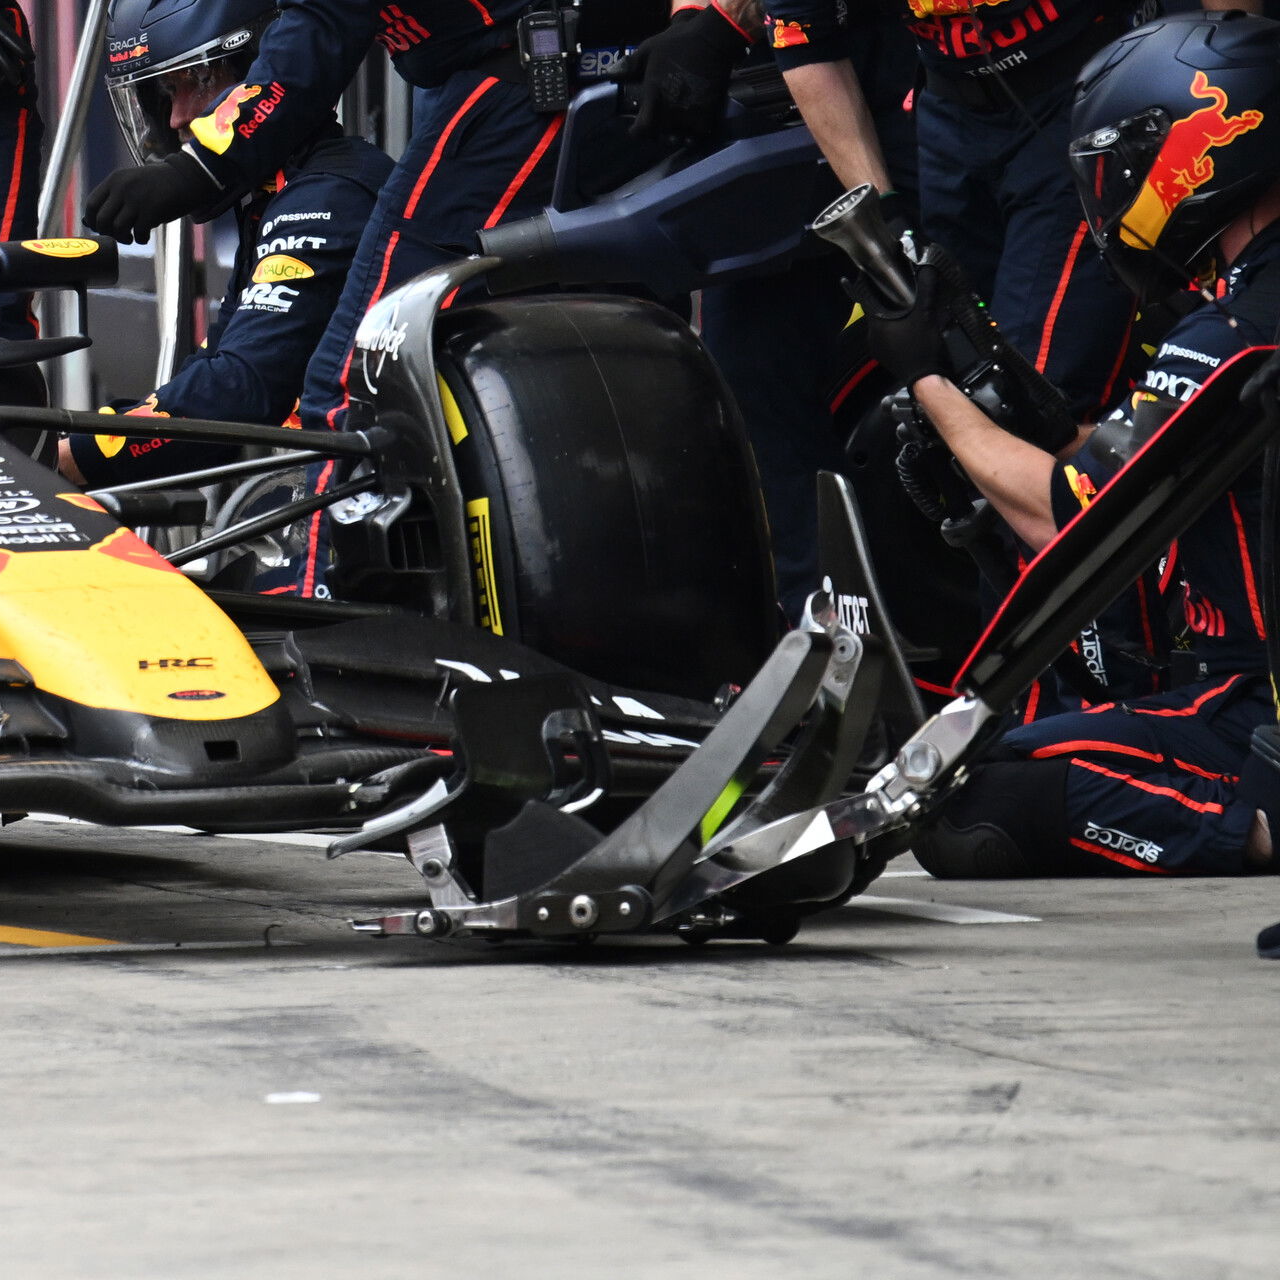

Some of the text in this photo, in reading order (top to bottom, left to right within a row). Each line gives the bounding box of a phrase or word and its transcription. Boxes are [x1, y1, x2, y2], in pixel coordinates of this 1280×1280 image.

[110, 33, 148, 51] ORACLE
[237, 107, 268, 139] Red
[1084, 822, 1164, 863] sparco
